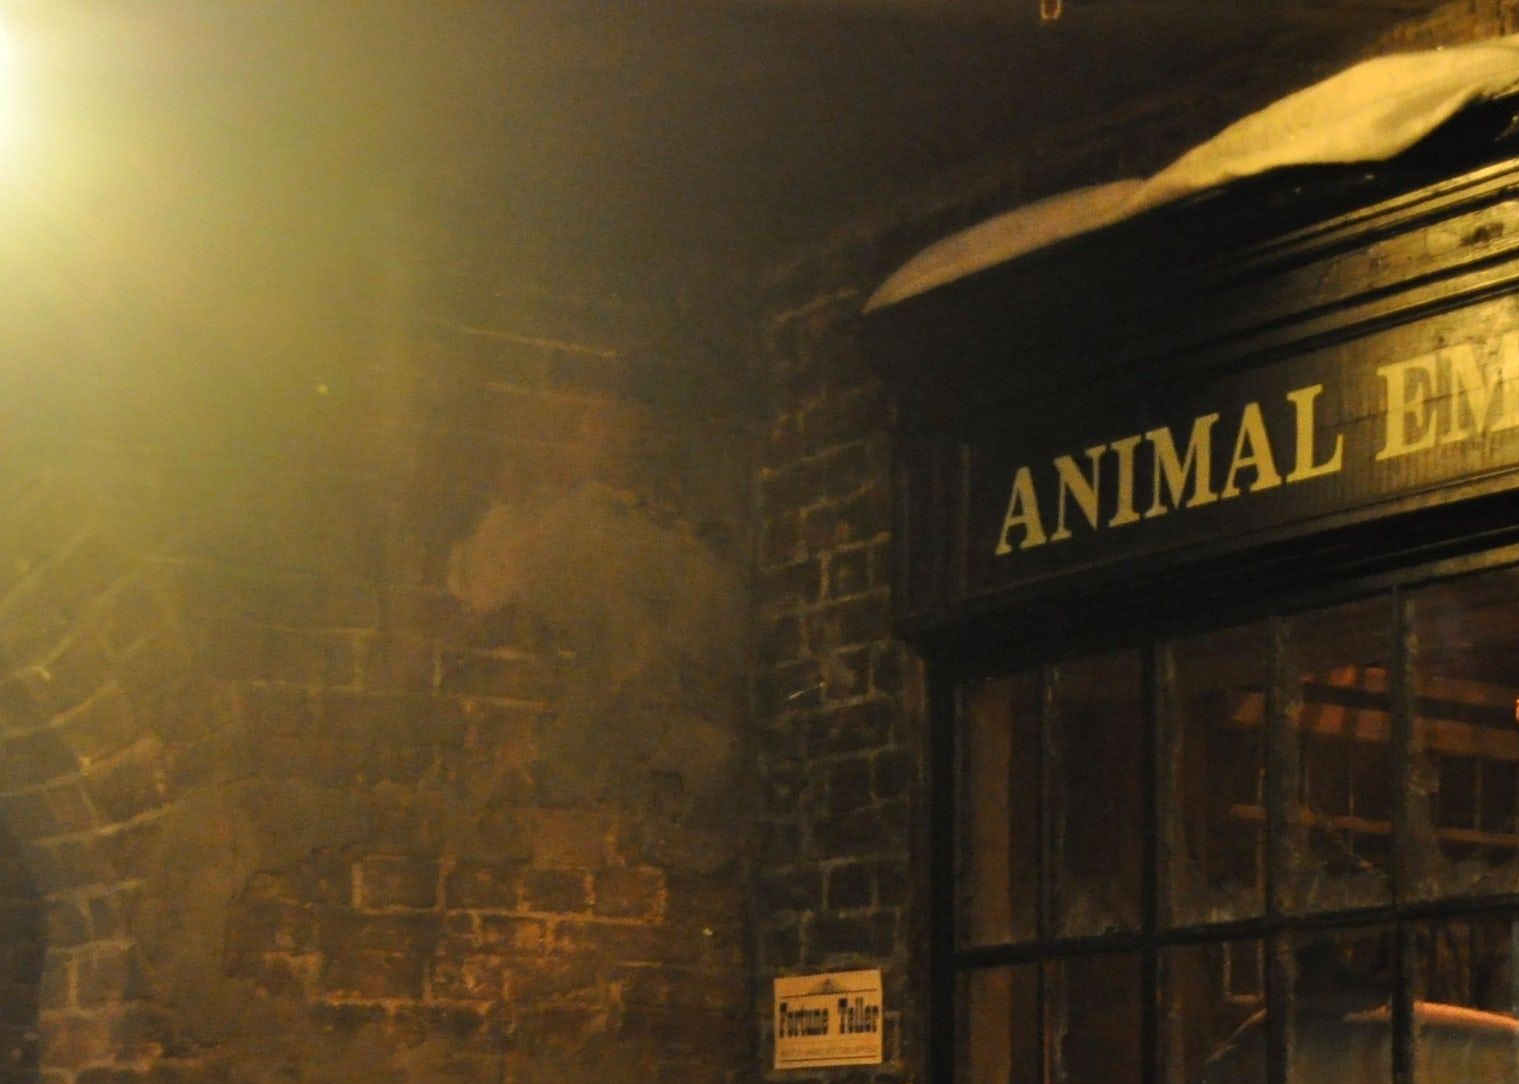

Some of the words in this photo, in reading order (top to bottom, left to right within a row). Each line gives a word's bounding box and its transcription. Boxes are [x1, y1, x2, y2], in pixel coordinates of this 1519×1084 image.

[994, 383, 1345, 556] ANIMAL
[779, 1002, 829, 1039] Fortune
[838, 997, 879, 1035] Teller
